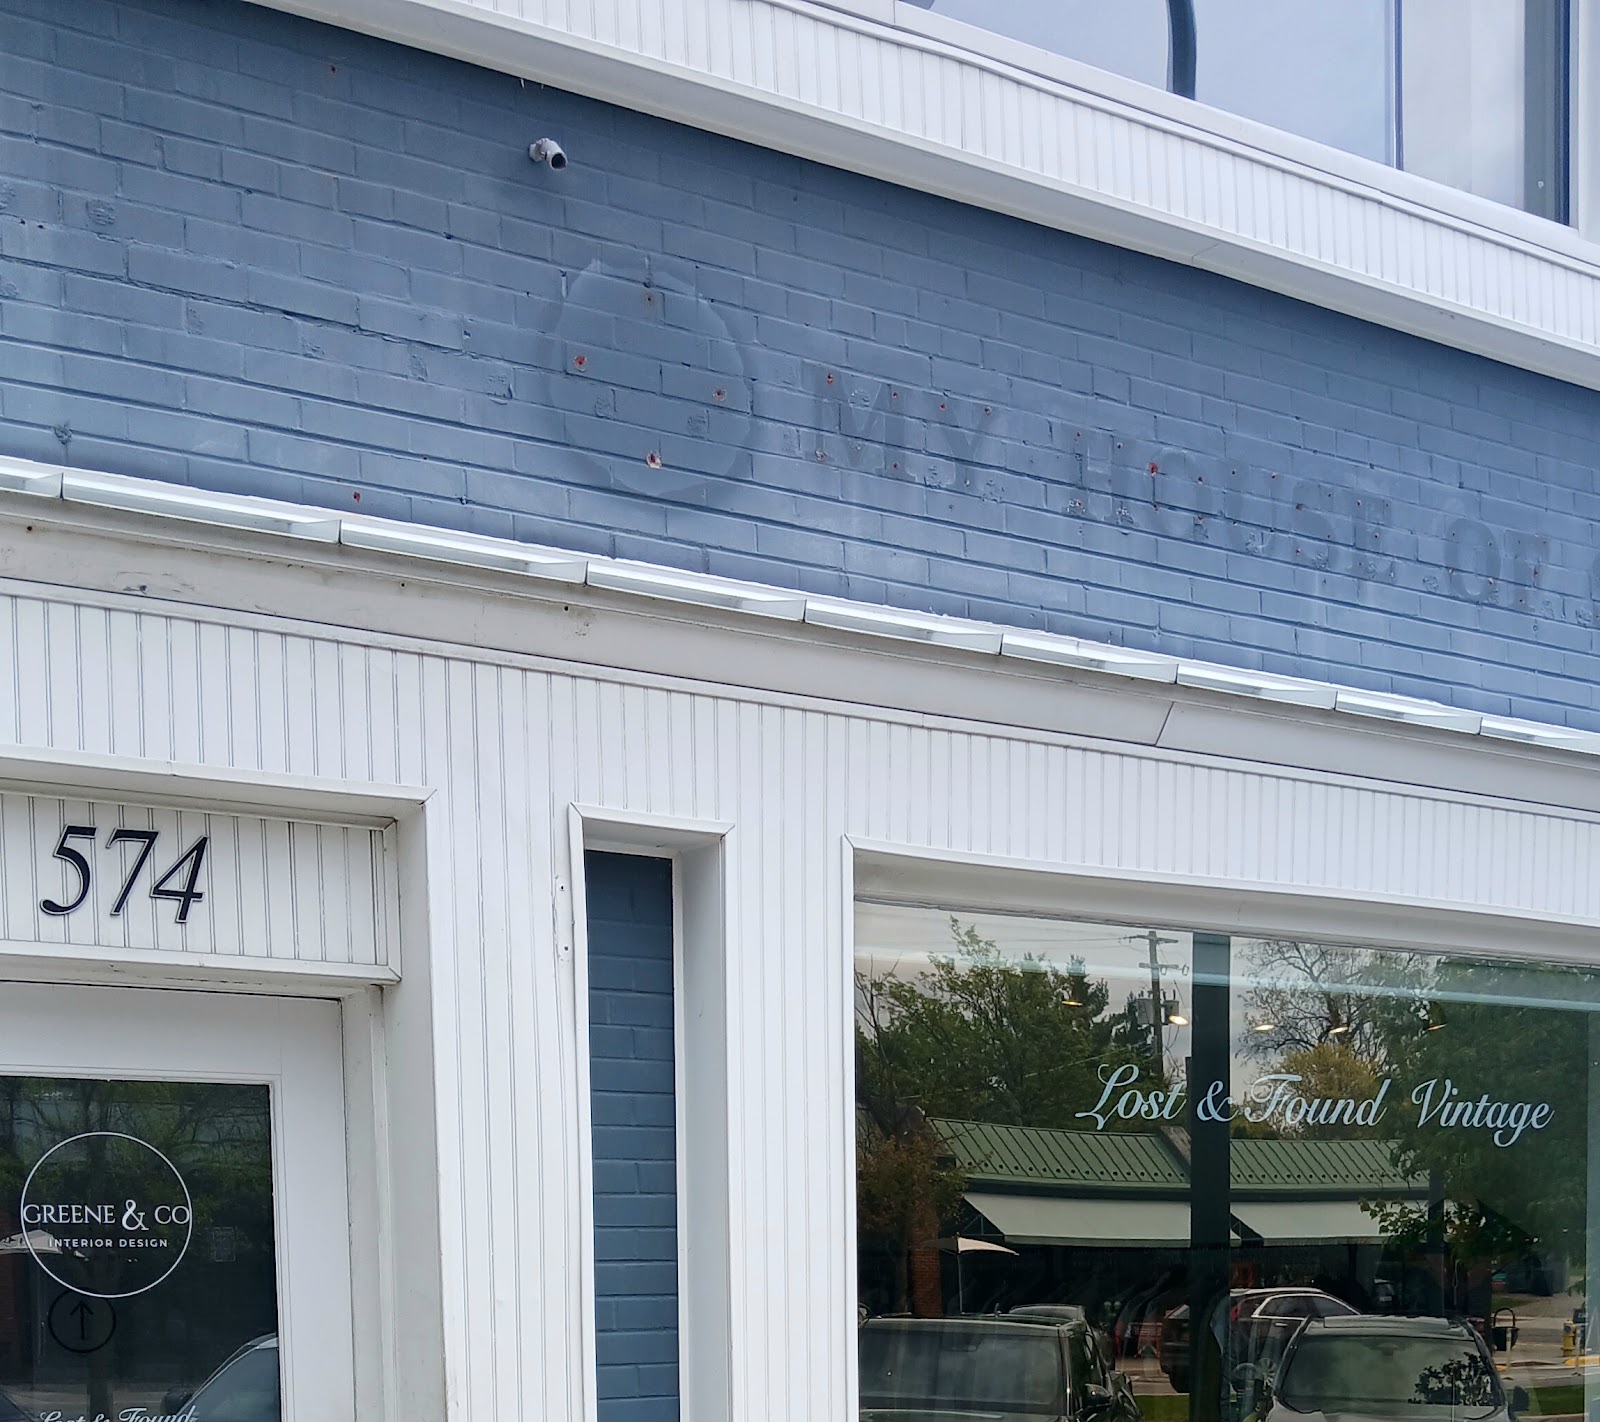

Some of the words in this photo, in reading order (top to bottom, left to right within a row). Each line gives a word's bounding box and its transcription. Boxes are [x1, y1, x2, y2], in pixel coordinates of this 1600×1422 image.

[1444, 517, 1549, 613] OF
[39, 823, 210, 923] 574
[1075, 1064, 1187, 1130] Lost
[1196, 1080, 1239, 1123] &
[1244, 1074, 1392, 1127] Found
[1412, 1078, 1554, 1147] Vintage
[23, 1204, 115, 1225] GREENE
[121, 1200, 149, 1231] &
[155, 1205, 191, 1225] CO
[49, 1238, 113, 1248] INTERIOR
[119, 1238, 169, 1248] DESIGN
